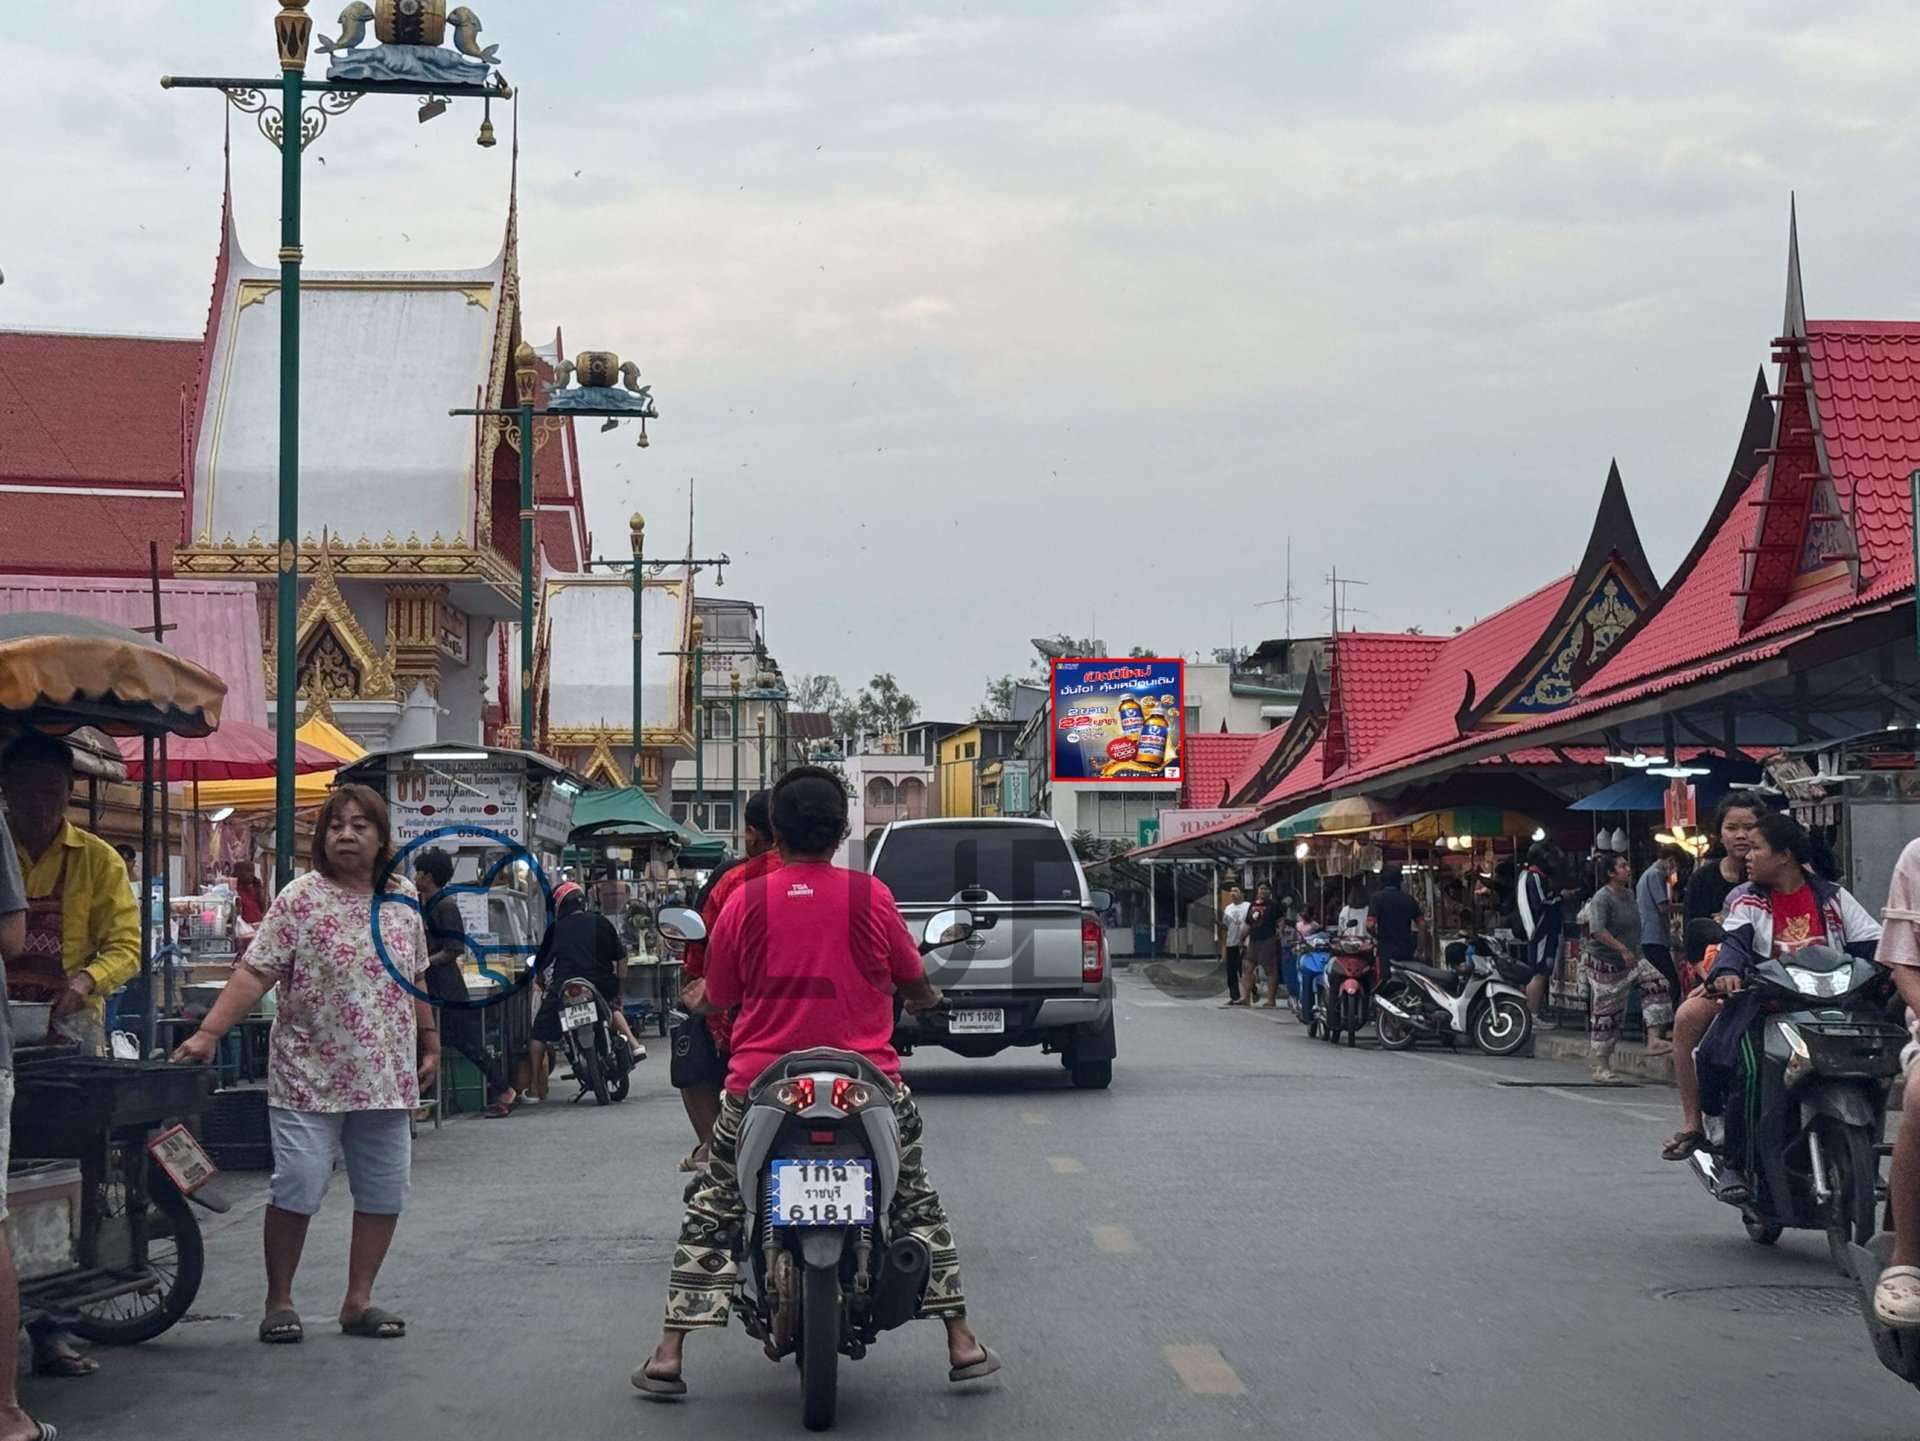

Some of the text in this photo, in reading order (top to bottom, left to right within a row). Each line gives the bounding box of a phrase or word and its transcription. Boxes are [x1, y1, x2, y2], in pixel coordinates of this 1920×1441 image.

[1058, 715, 1092, 730] 22
[396, 759, 427, 802] ข้าว
[500, 806, 518, 814] บาท
[457, 828, 519, 839] 0362140
[976, 1011, 1001, 1022] 1302
[804, 1185, 842, 1202] ราชบุรี
[789, 1204, 854, 1221] 6181
